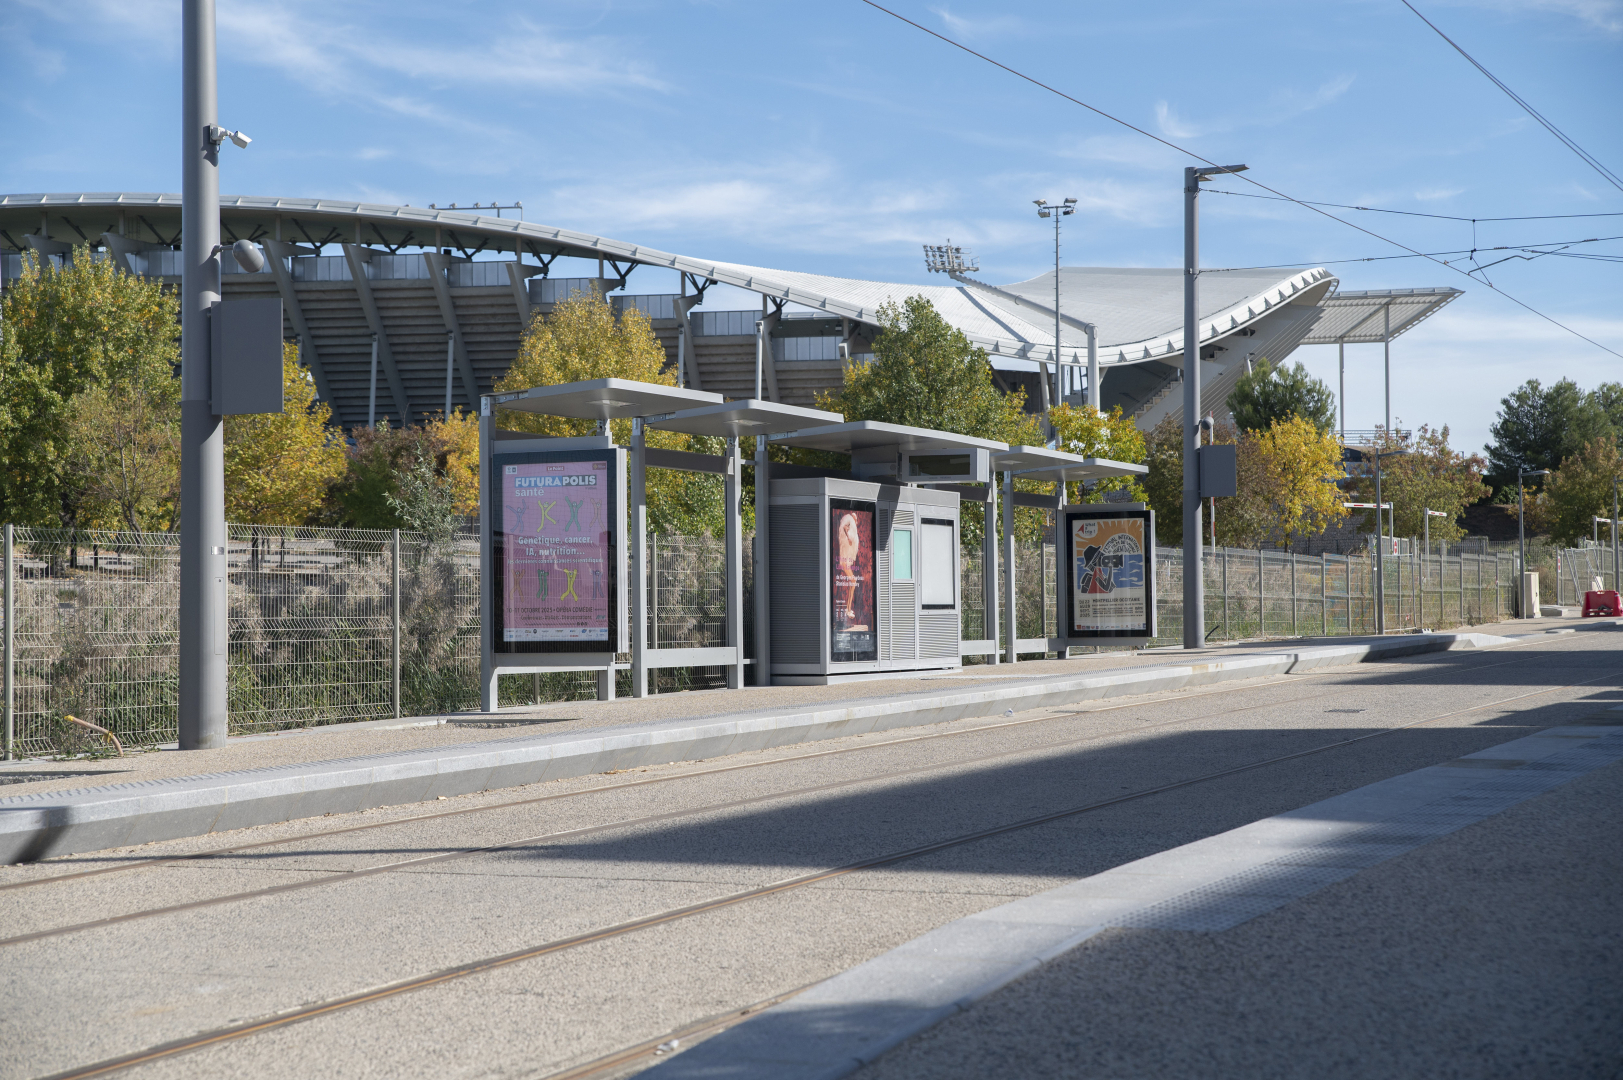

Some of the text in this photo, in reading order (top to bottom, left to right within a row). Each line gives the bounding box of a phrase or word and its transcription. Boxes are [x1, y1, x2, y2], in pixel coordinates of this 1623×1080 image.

[515, 486, 544, 497] santé
[518, 535, 593, 546] Génétique, cancer,
[525, 547, 537, 556] IA,
